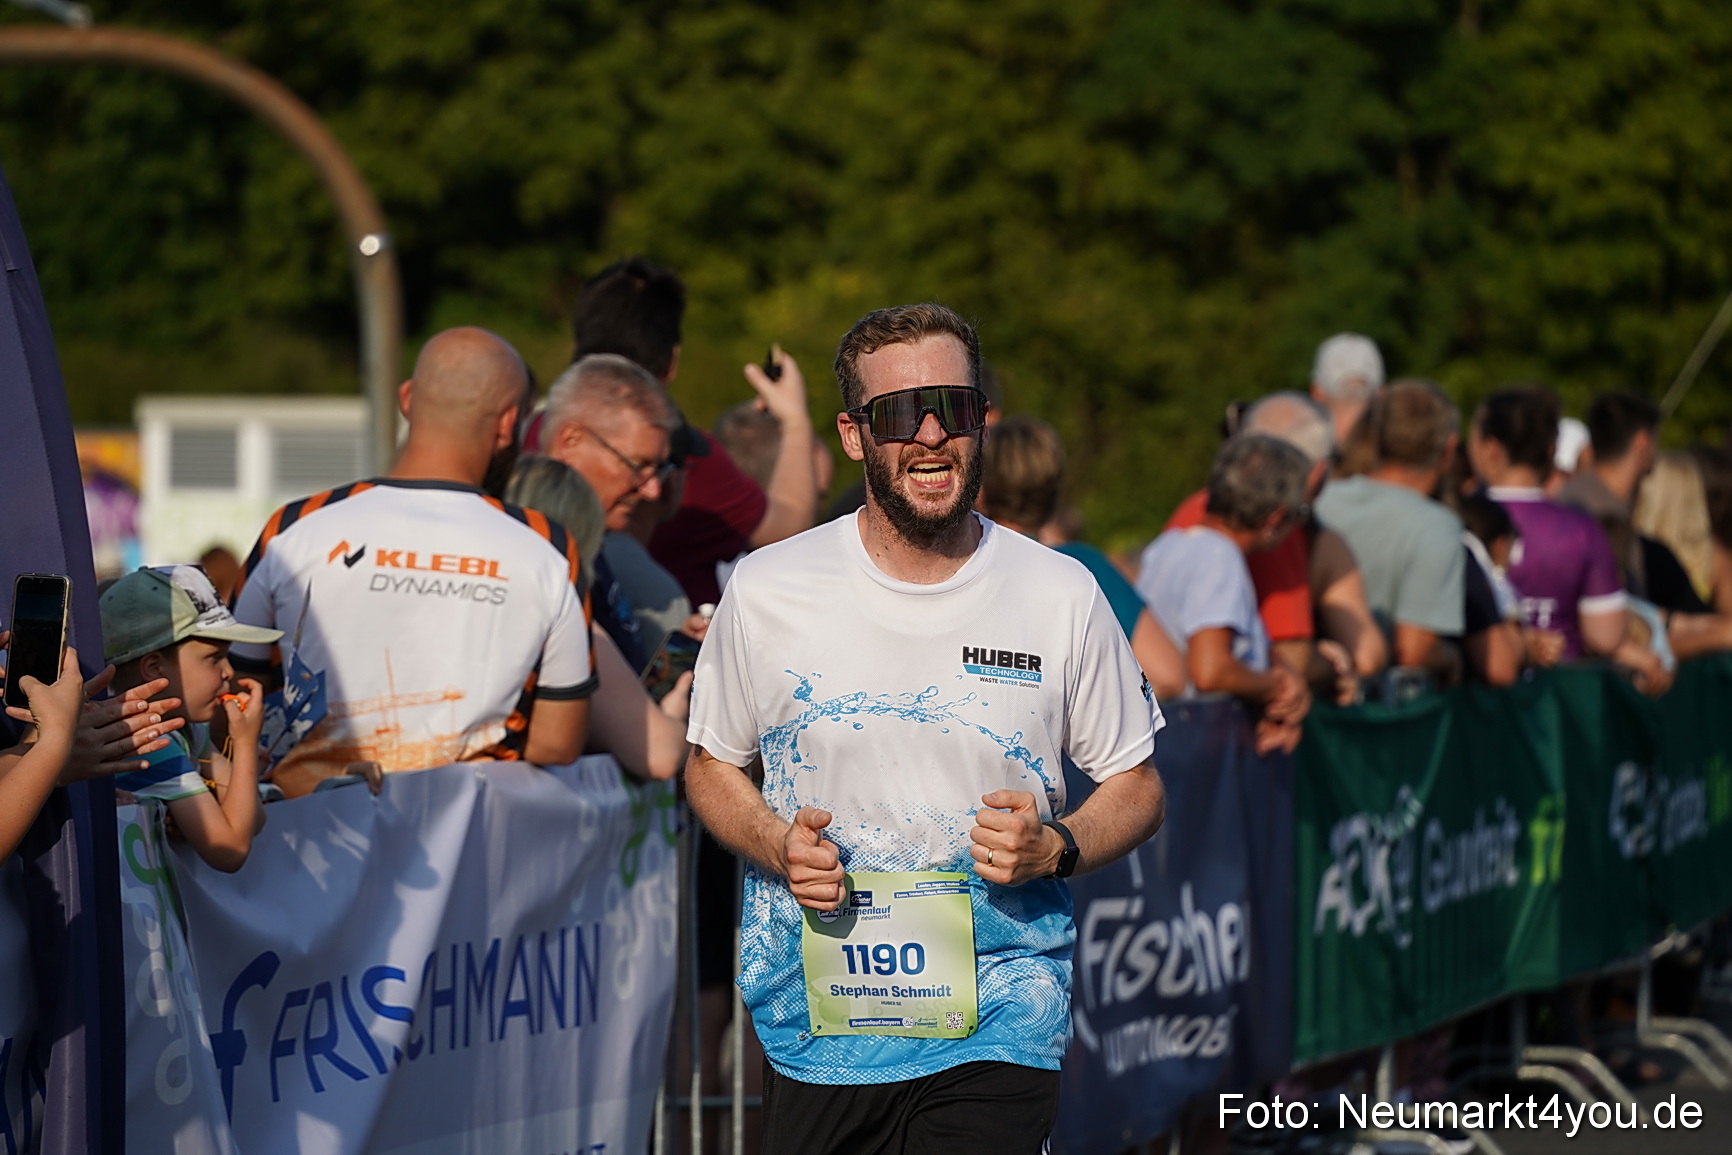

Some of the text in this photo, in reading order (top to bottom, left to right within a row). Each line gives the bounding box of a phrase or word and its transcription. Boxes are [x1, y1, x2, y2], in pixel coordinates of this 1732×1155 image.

[375, 549, 509, 580] KLEBL
[369, 574, 507, 605] DYNAMICS
[962, 646, 1042, 672] HUBER
[979, 666, 1040, 680] TECHNOLOGY
[979, 676, 998, 684] WASTE
[1018, 681, 1040, 689] Solutions
[843, 905, 892, 916] Firmenlauf
[842, 943, 925, 976] 1190
[830, 984, 952, 998] Stephan Schmidt
[270, 921, 601, 1102] FRISCHMANN
